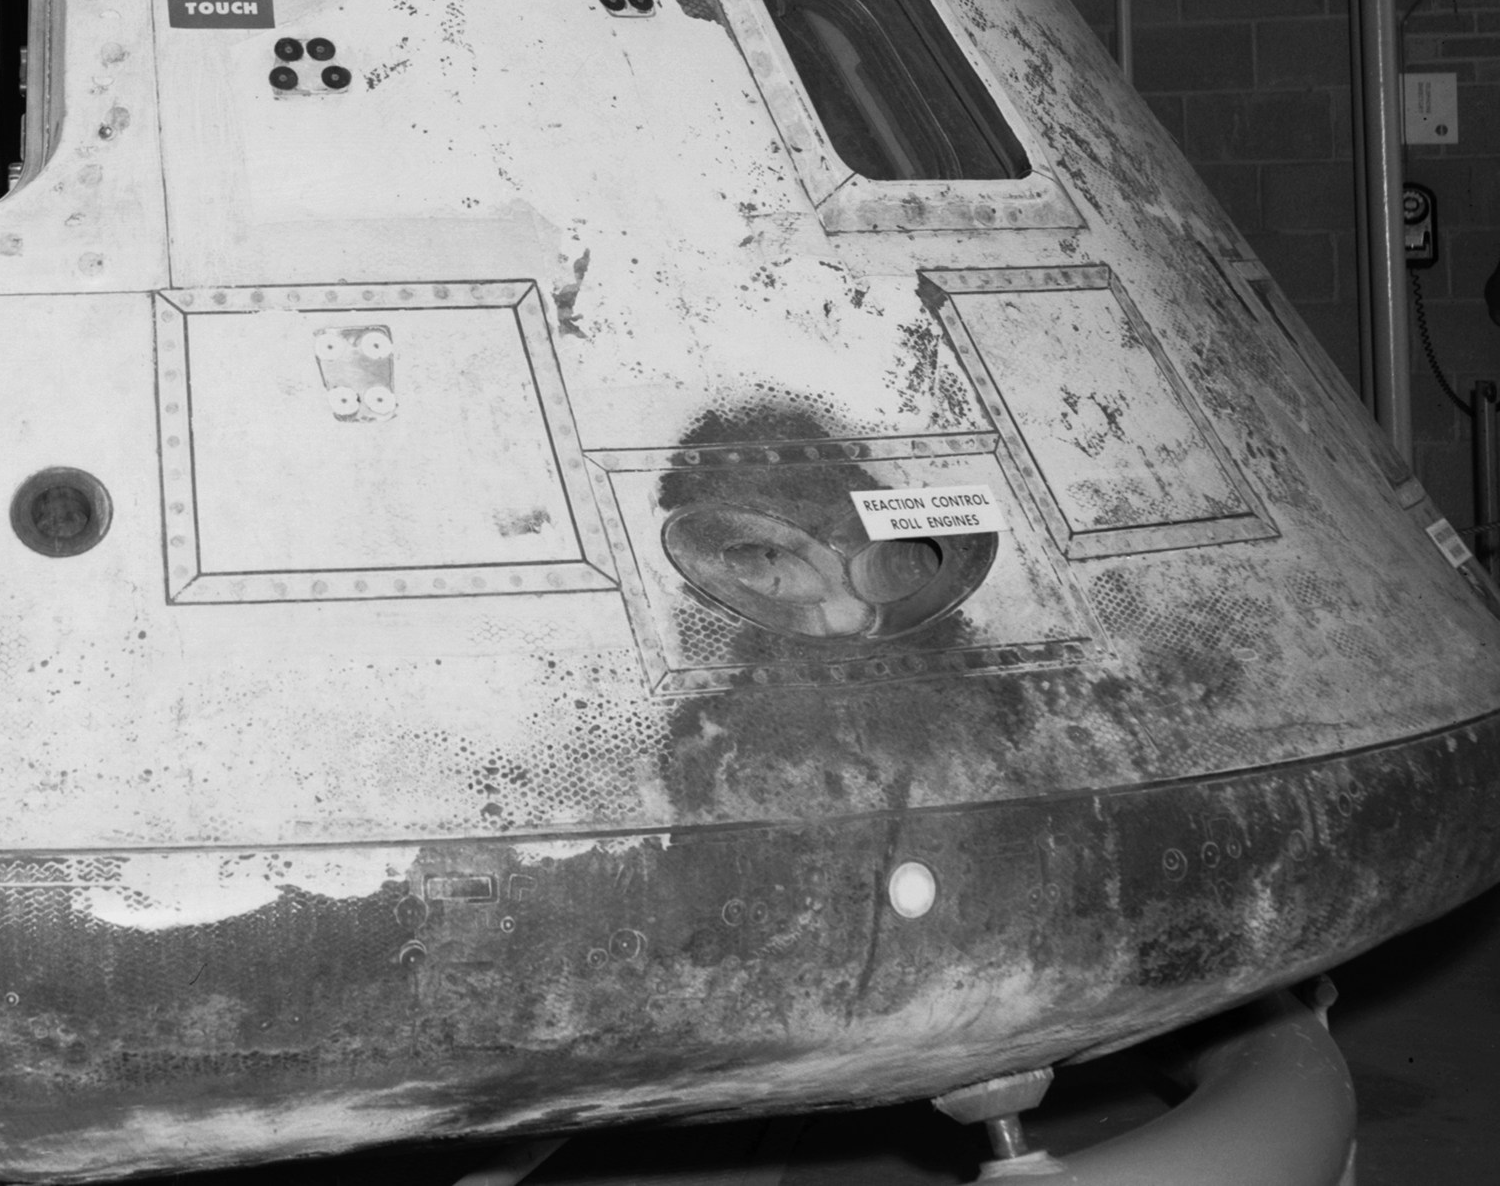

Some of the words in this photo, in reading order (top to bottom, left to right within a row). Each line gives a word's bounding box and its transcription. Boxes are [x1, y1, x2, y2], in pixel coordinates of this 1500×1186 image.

[184, 1, 258, 15] TOUCH
[863, 497, 926, 512] REACTION
[931, 493, 990, 508] CONTROL
[890, 518, 923, 530] ROLL
[926, 514, 980, 529] ENGINES
